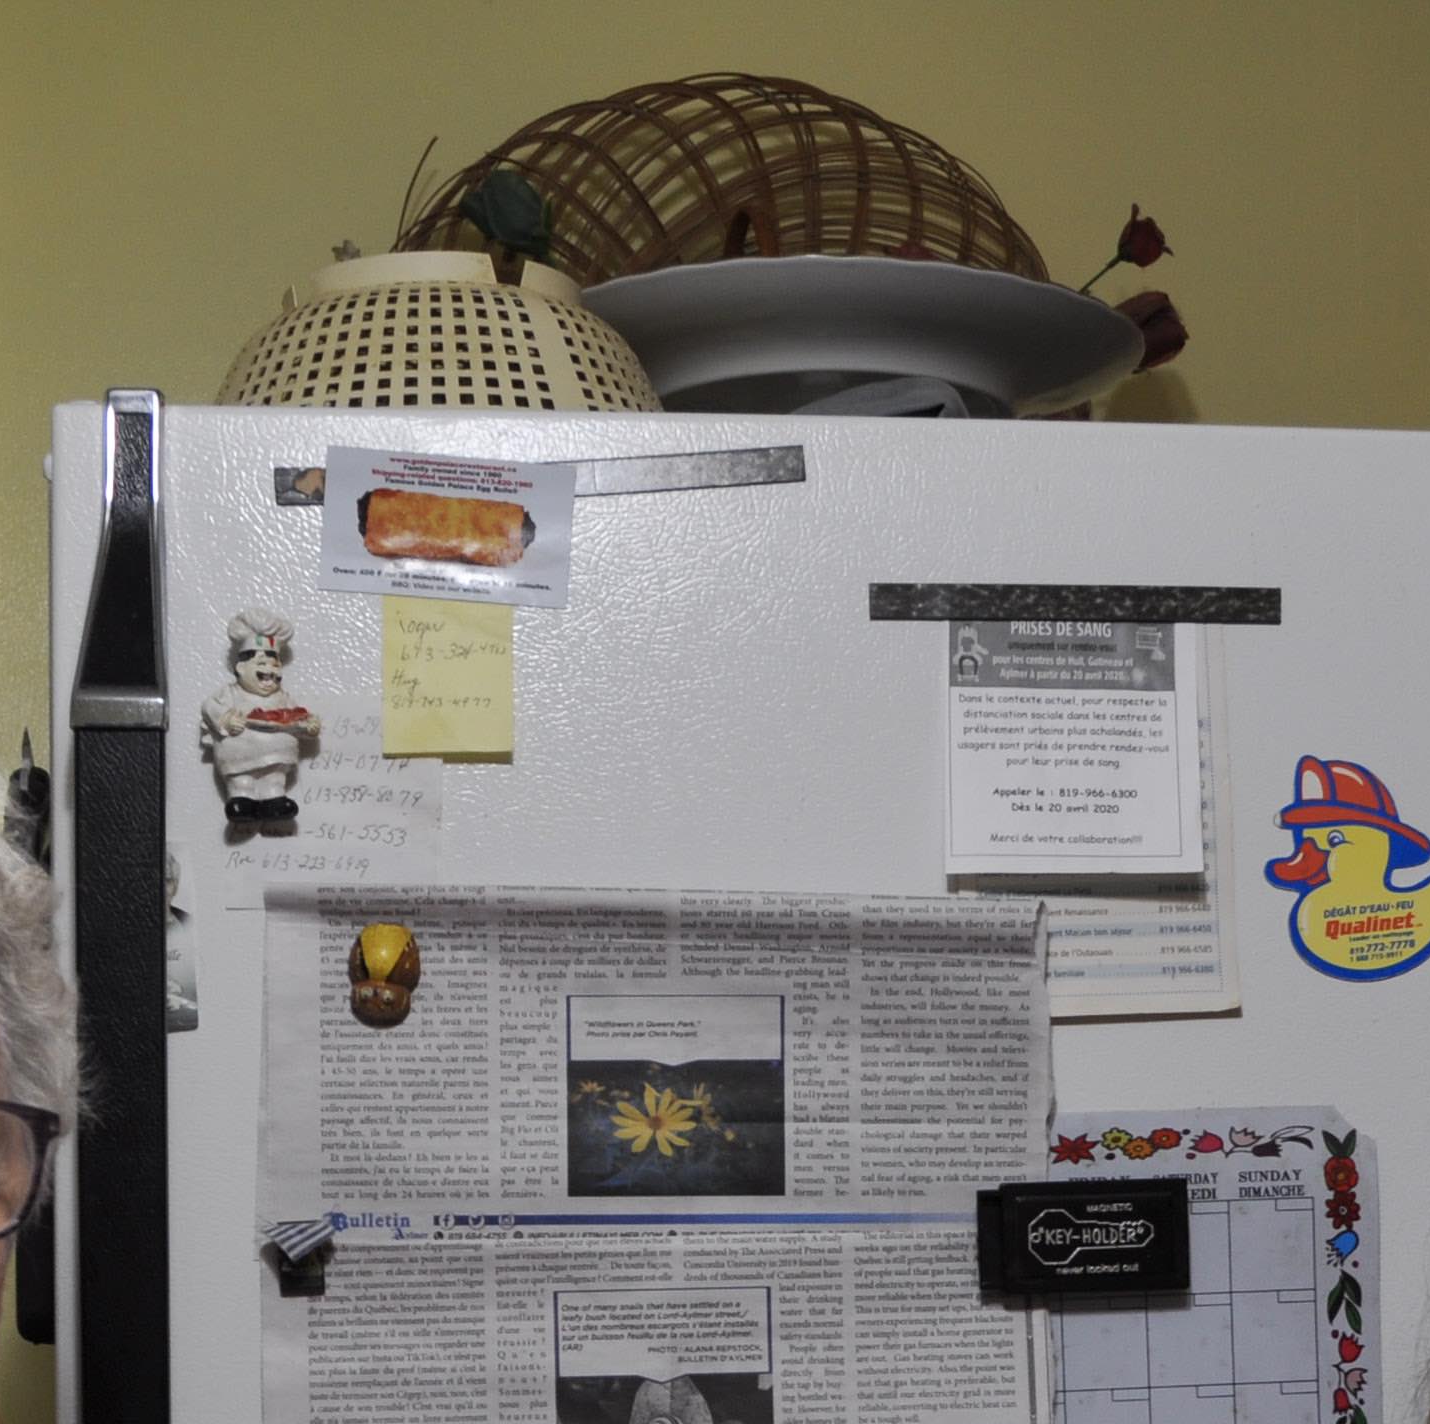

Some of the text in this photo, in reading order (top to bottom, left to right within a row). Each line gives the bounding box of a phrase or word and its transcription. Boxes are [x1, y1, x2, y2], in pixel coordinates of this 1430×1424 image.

[1010, 621, 1111, 637] PRISES DE SANG
[992, 655, 1133, 667] pour les centres de Hull, Gatineau et
[958, 693, 1167, 709] Dans le contexte actuel, pour respecter la
[963, 709, 1162, 721] distanciation sociale dans les centres de
[962, 725, 1163, 739] prélèvement urbains plus achalandés, les
[957, 741, 1169, 754] usagers sont priés de prendre rendez-vous
[1005, 758, 1028, 768] pour
[1031, 757, 1050, 766] leur
[1053, 757, 1079, 768] prise
[1082, 757, 1094, 767] de
[992, 788, 1031, 799] Appeler
[1035, 788, 1045, 798] le
[1058, 788, 1137, 798] 819-966-6300
[1010, 802, 1119, 813] Dès le 20 avril 2020
[989, 833, 1019, 843] Merci
[1021, 833, 1034, 843] de
[1037, 833, 1064, 843] votre
[1324, 900, 1414, 919] DÉGÂT D'EAU FEU
[1326, 912, 1415, 939] Qualinet
[870, 987, 1030, 997] In the end, Hollywood, like most
[860, 1001, 1030, 1012] industries, will follow the money. As
[1238, 1169, 1301, 1183] SUNDAY
[1239, 1185, 1305, 1198] DIMANCHE
[328, 1211, 411, 1230] Bulletin
[1122, 1263, 1139, 1272] out
